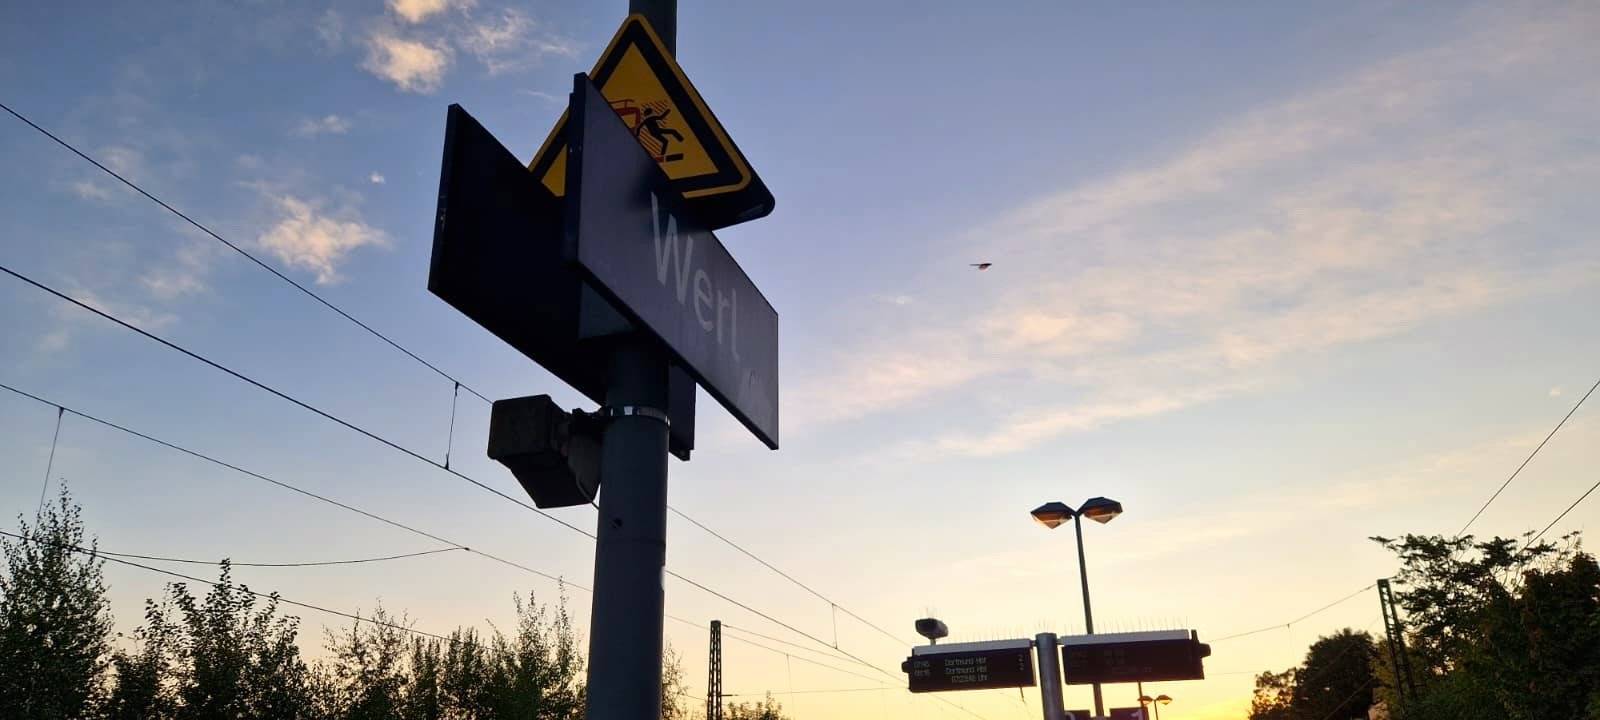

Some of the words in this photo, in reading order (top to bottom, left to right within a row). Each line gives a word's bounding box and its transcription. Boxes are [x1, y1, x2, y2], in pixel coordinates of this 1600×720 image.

[650, 191, 741, 362] Werl
[944, 657, 974, 666] Dortmund
[944, 666, 975, 675] Dortmund
